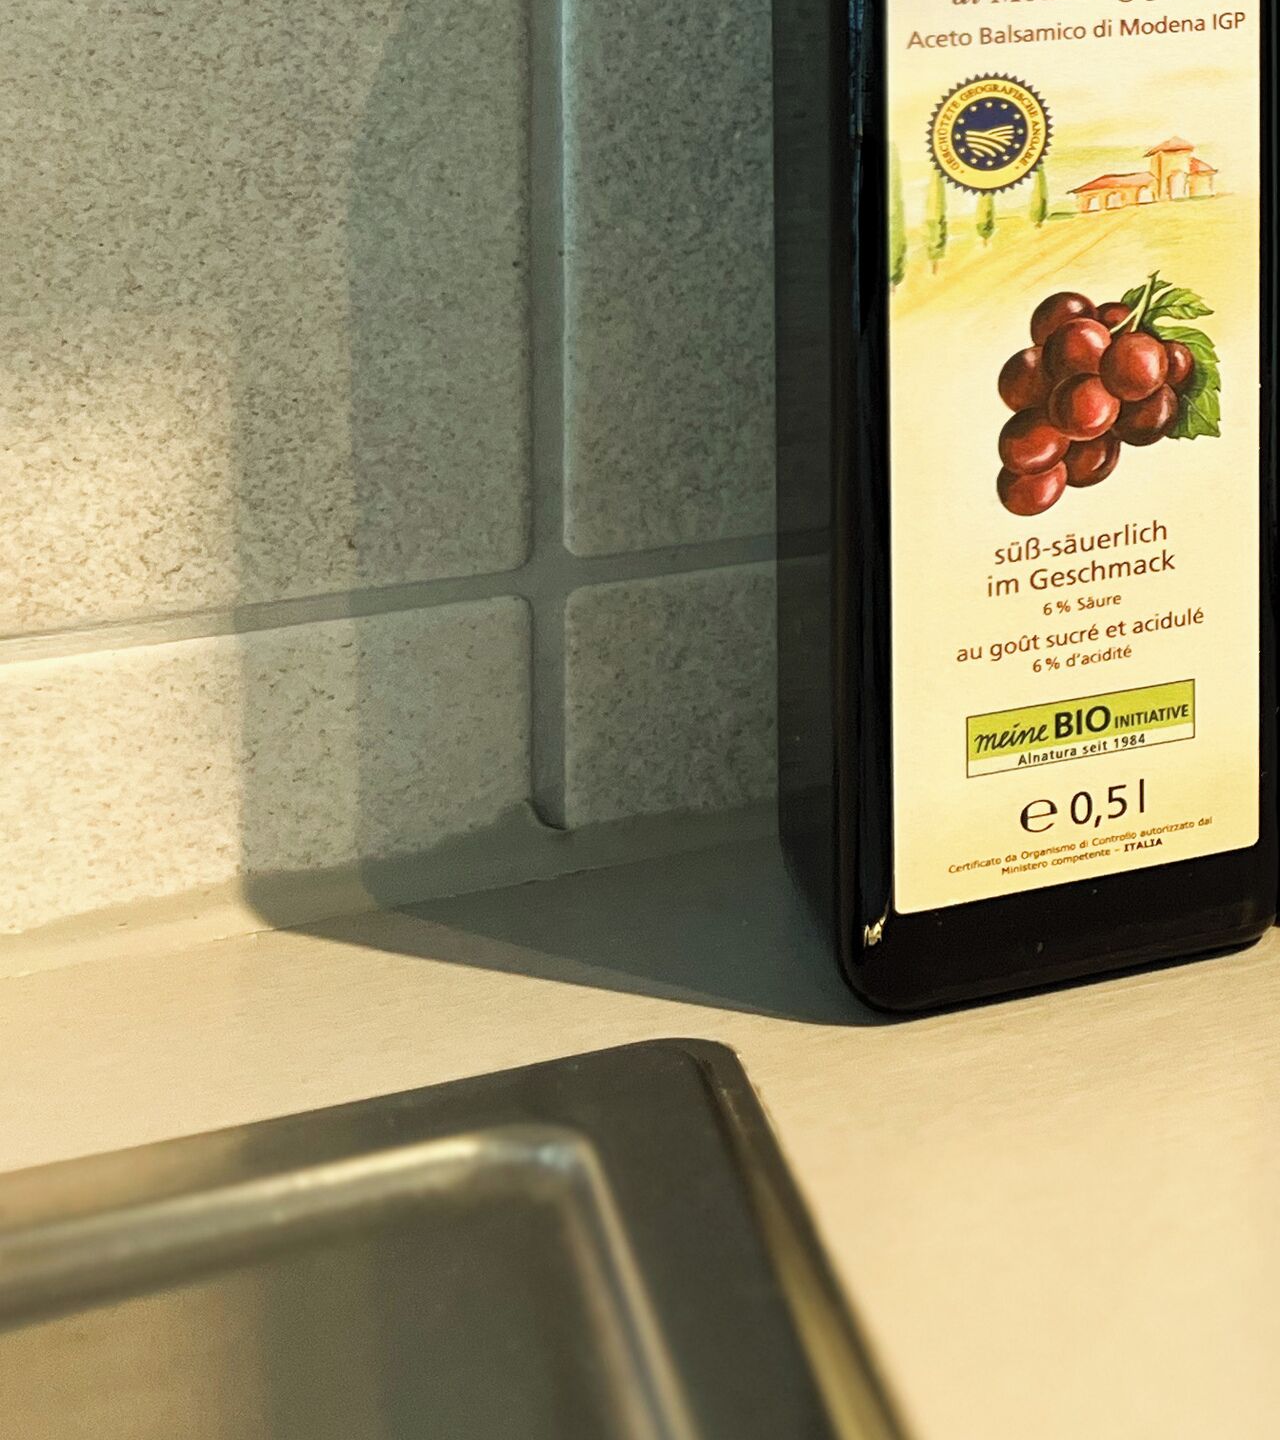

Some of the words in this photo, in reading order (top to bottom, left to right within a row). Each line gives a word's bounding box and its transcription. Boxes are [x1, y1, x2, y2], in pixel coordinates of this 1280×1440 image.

[906, 31, 972, 50] Aceto
[980, 24, 1086, 44] Balsamico
[1093, 22, 1112, 38] di
[1120, 16, 1206, 36] Modena
[1213, 12, 1246, 30] IGP
[994, 520, 1167, 566] süß-säuerlich
[988, 576, 1019, 597] im
[1030, 550, 1175, 590] Geschmack
[1043, 603, 1052, 616] 6
[1056, 601, 1071, 614] %
[1078, 593, 1122, 611] Säure
[956, 645, 982, 662] au
[990, 634, 1041, 661] goût
[1046, 626, 1099, 648] sucré
[1106, 622, 1125, 638] et
[1132, 608, 1204, 634] acidulé
[1032, 660, 1042, 673] 6
[1045, 657, 1060, 671] %
[974, 722, 1048, 754] meine
[1054, 706, 1111, 739] BIO
[1114, 704, 1189, 729] INITIATIVE
[1018, 746, 1077, 766] Alnatura
[1083, 741, 1108, 754] seit
[1114, 733, 1146, 749] 1984
[1070, 784, 1128, 827] 0,5
[948, 855, 1002, 874] Certificato
[1005, 853, 1017, 863] da
[1021, 841, 1076, 860] Organismo
[1079, 839, 1089, 849] di
[1092, 831, 1137, 847] Controllo
[1140, 819, 1195, 837] autorizzato
[1198, 816, 1212, 827] dal
[1001, 859, 1047, 875] Ministero
[1051, 847, 1111, 868] competente
[1124, 837, 1163, 852] ITALIA
